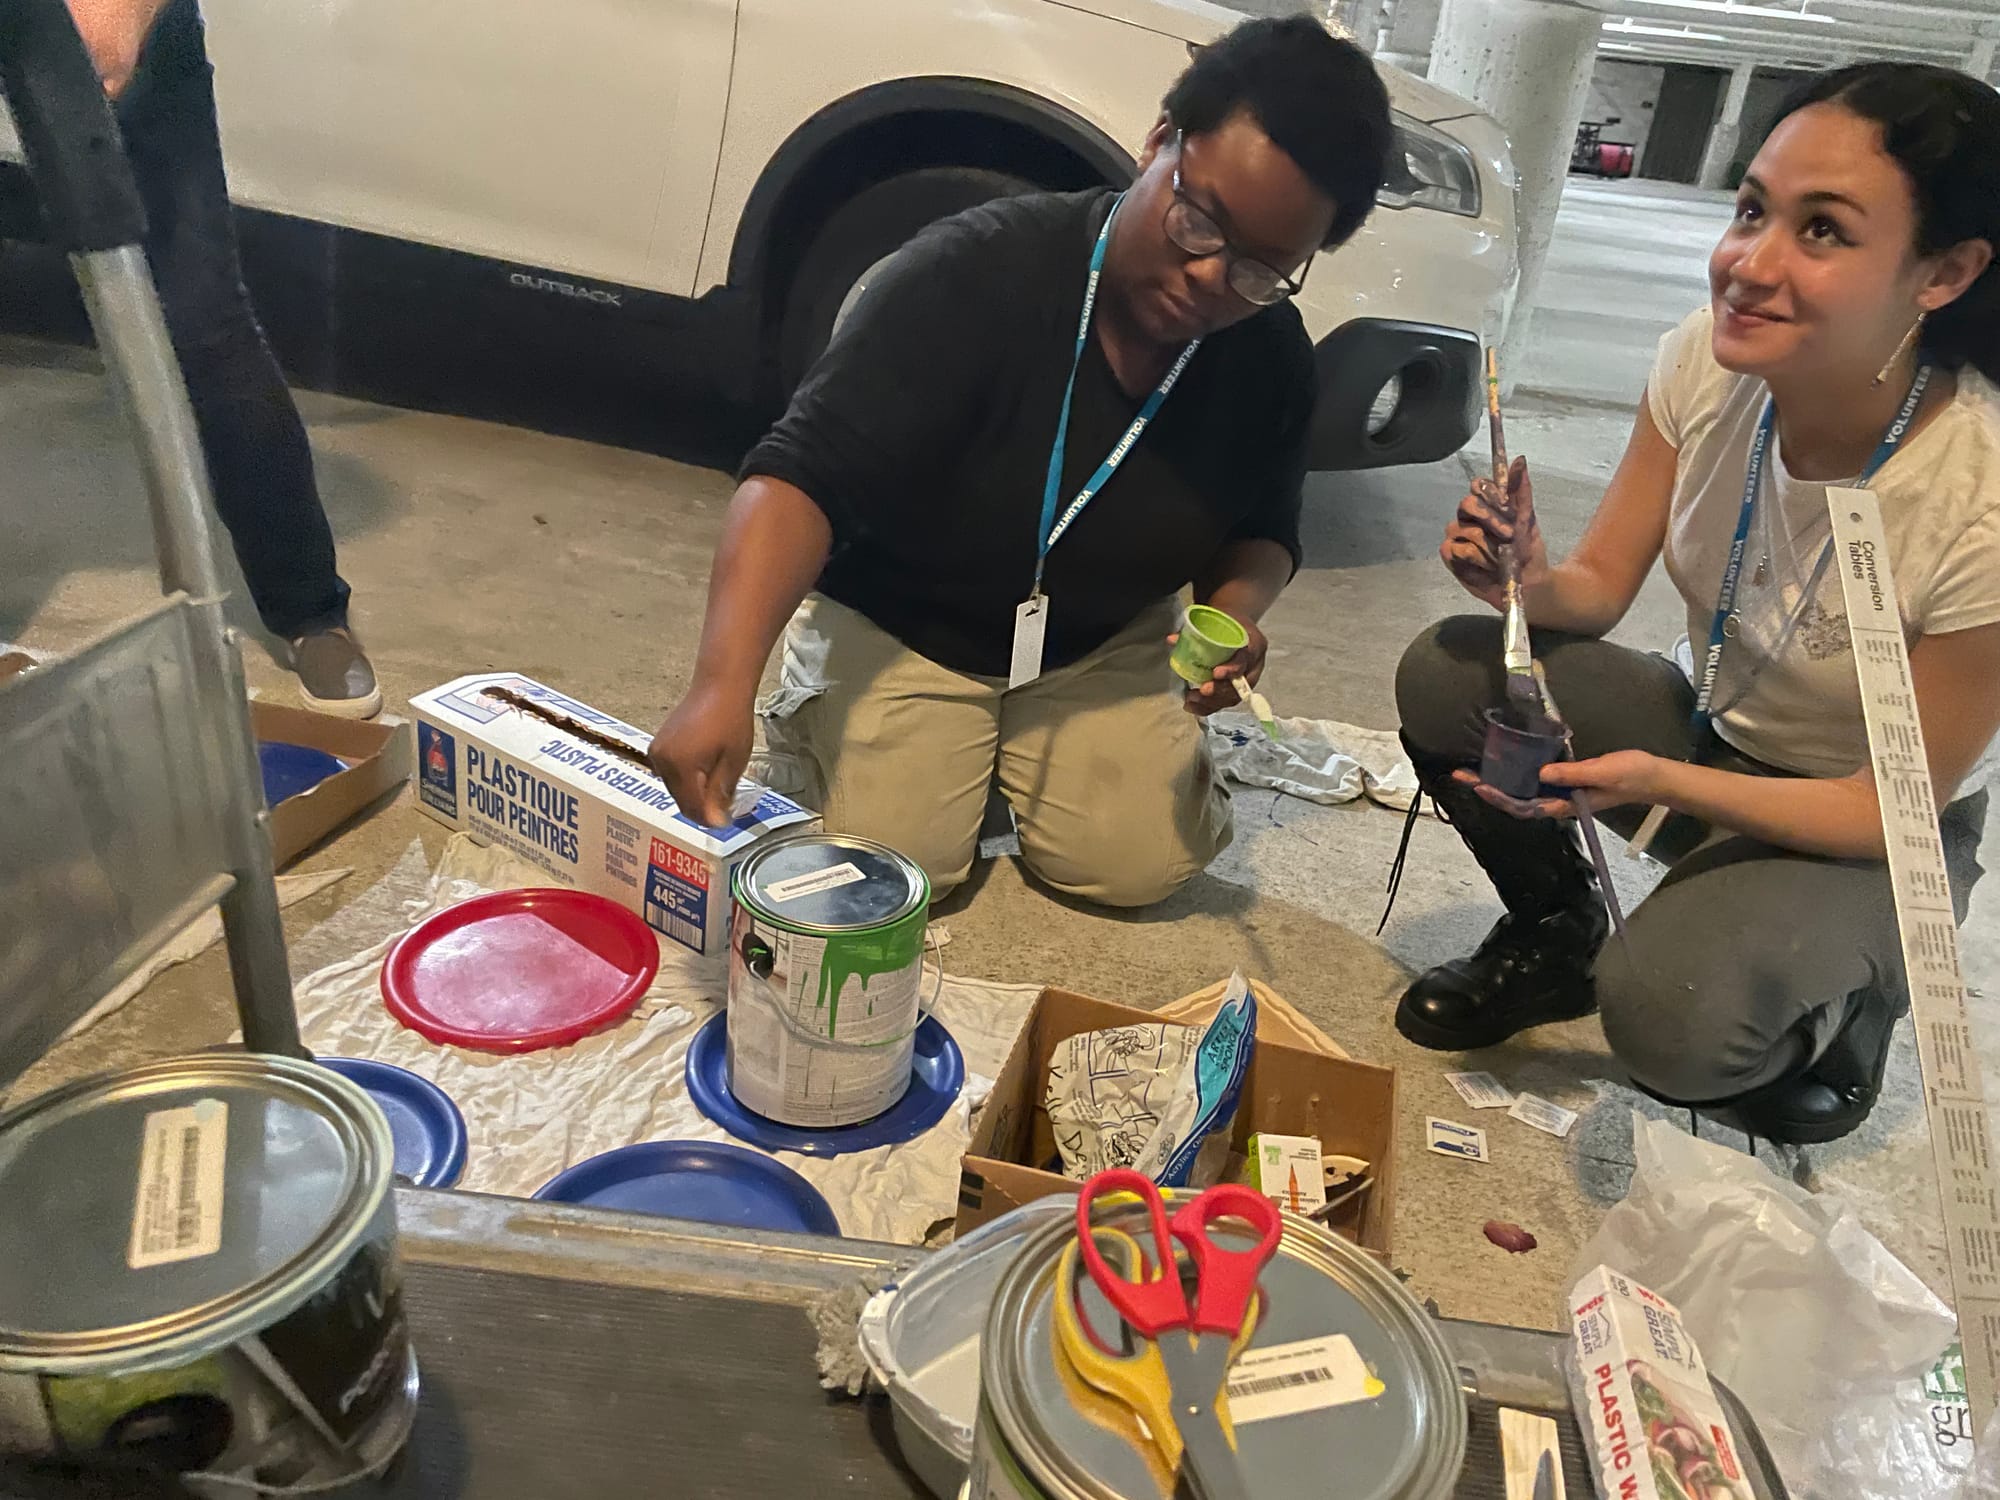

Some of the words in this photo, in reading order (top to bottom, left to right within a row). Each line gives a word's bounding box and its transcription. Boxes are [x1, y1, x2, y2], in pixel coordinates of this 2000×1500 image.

[510, 273, 622, 307] OUTBACK
[1078, 270, 1100, 340] VOLUNTEER
[1158, 339, 1200, 394] VOLUNTEER
[1107, 417, 1148, 467] VOLUNTEER
[1745, 428, 1767, 503] VOLUNTEER
[1047, 489, 1093, 545] VOLUNTEER
[1719, 539, 1744, 610] VOLUNTEER
[1849, 539, 1864, 581] Tables
[1862, 540, 1883, 612] Conversion
[1696, 644, 1722, 711] VOLUNTEER
[540, 740, 608, 775] PLASTIC
[467, 744, 579, 830] PLASTIQUE
[467, 778, 505, 829] POUR
[509, 799, 579, 865] PEINTRES
[652, 841, 707, 885] 161-9345
[653, 885, 677, 909] 445
[1208, 1016, 1235, 1063] ARTIST
[1578, 1319, 1593, 1355] GREAT
[1643, 1305, 1669, 1360] GREAT
[1595, 1363, 1632, 1471] PLASTIC
